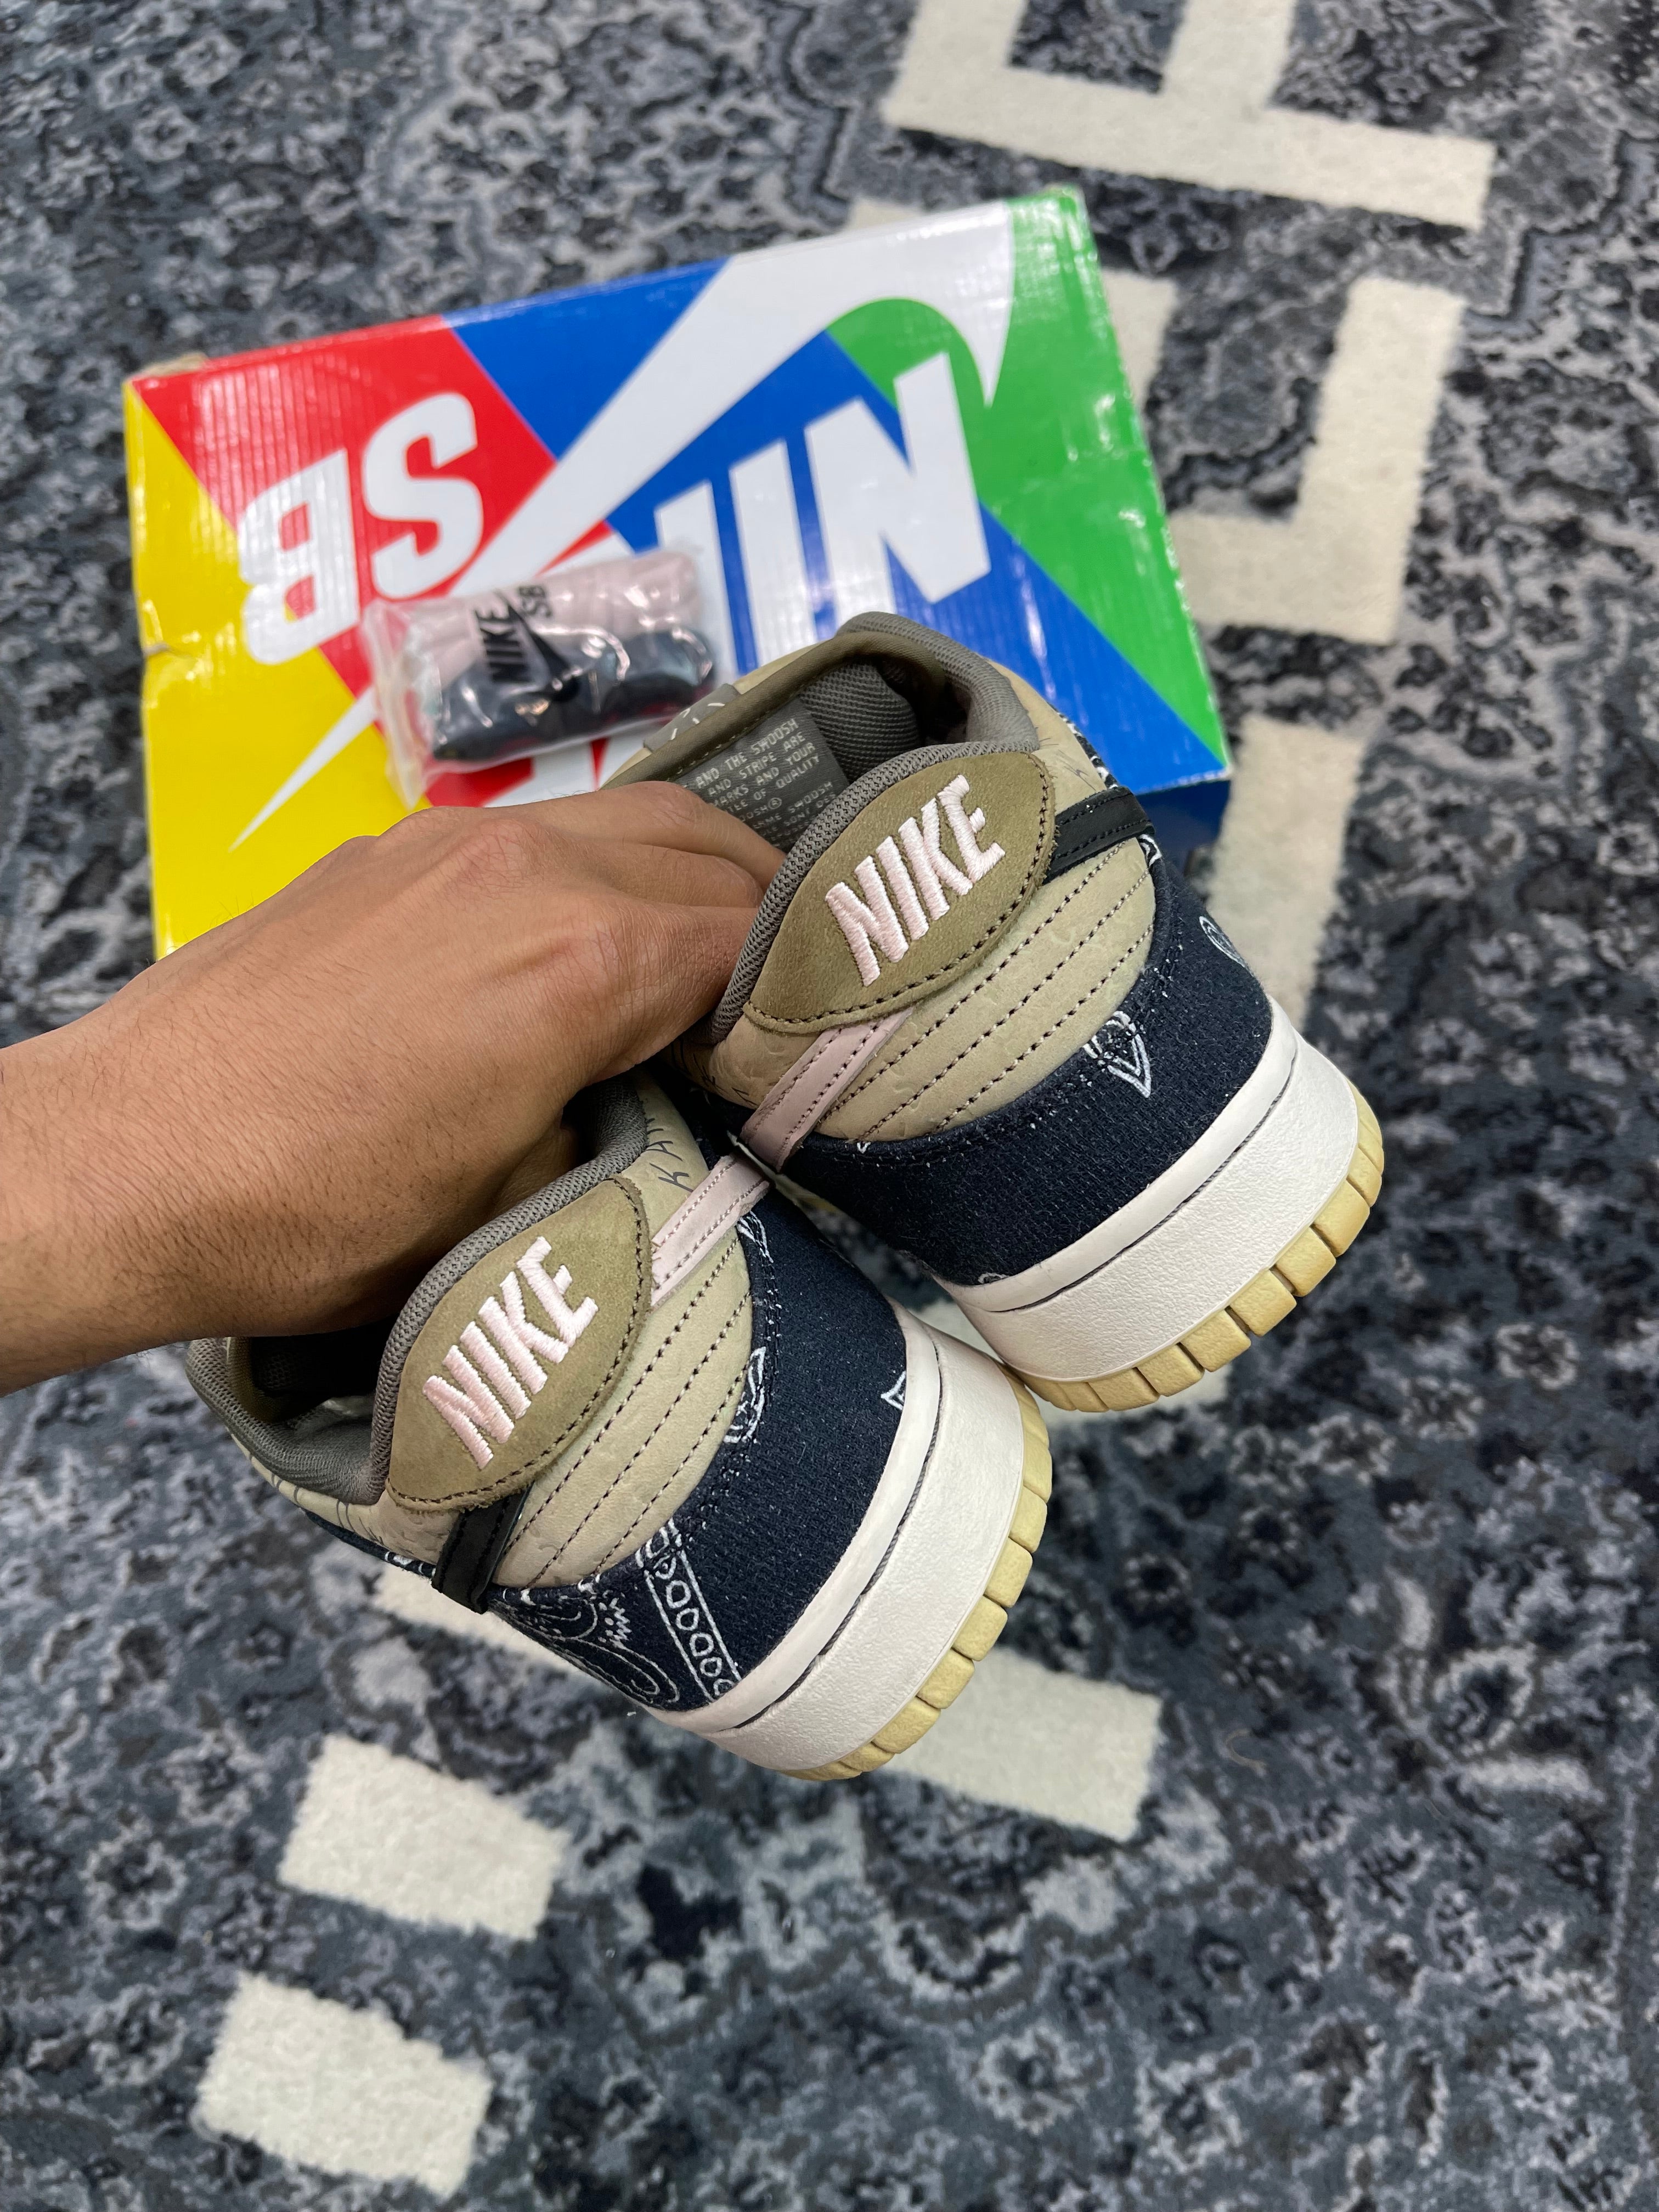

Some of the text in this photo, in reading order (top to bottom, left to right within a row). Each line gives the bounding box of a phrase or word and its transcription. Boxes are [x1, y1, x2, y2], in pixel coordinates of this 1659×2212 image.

[238, 392, 484, 665] SB
[519, 585, 553, 618] SB
[473, 602, 532, 684] NIKE
[696, 768, 720, 789] AND
[724, 752, 747, 770] THE
[708, 731, 806, 797] AND STRIPE ARE
[753, 788, 766, 800] OF
[776, 754, 820, 788] QUALITY
[756, 767, 780, 786] AND
[786, 742, 816, 765] YOUR
[825, 774, 1006, 987] NIKE
[422, 1235, 599, 1471] NIKE
